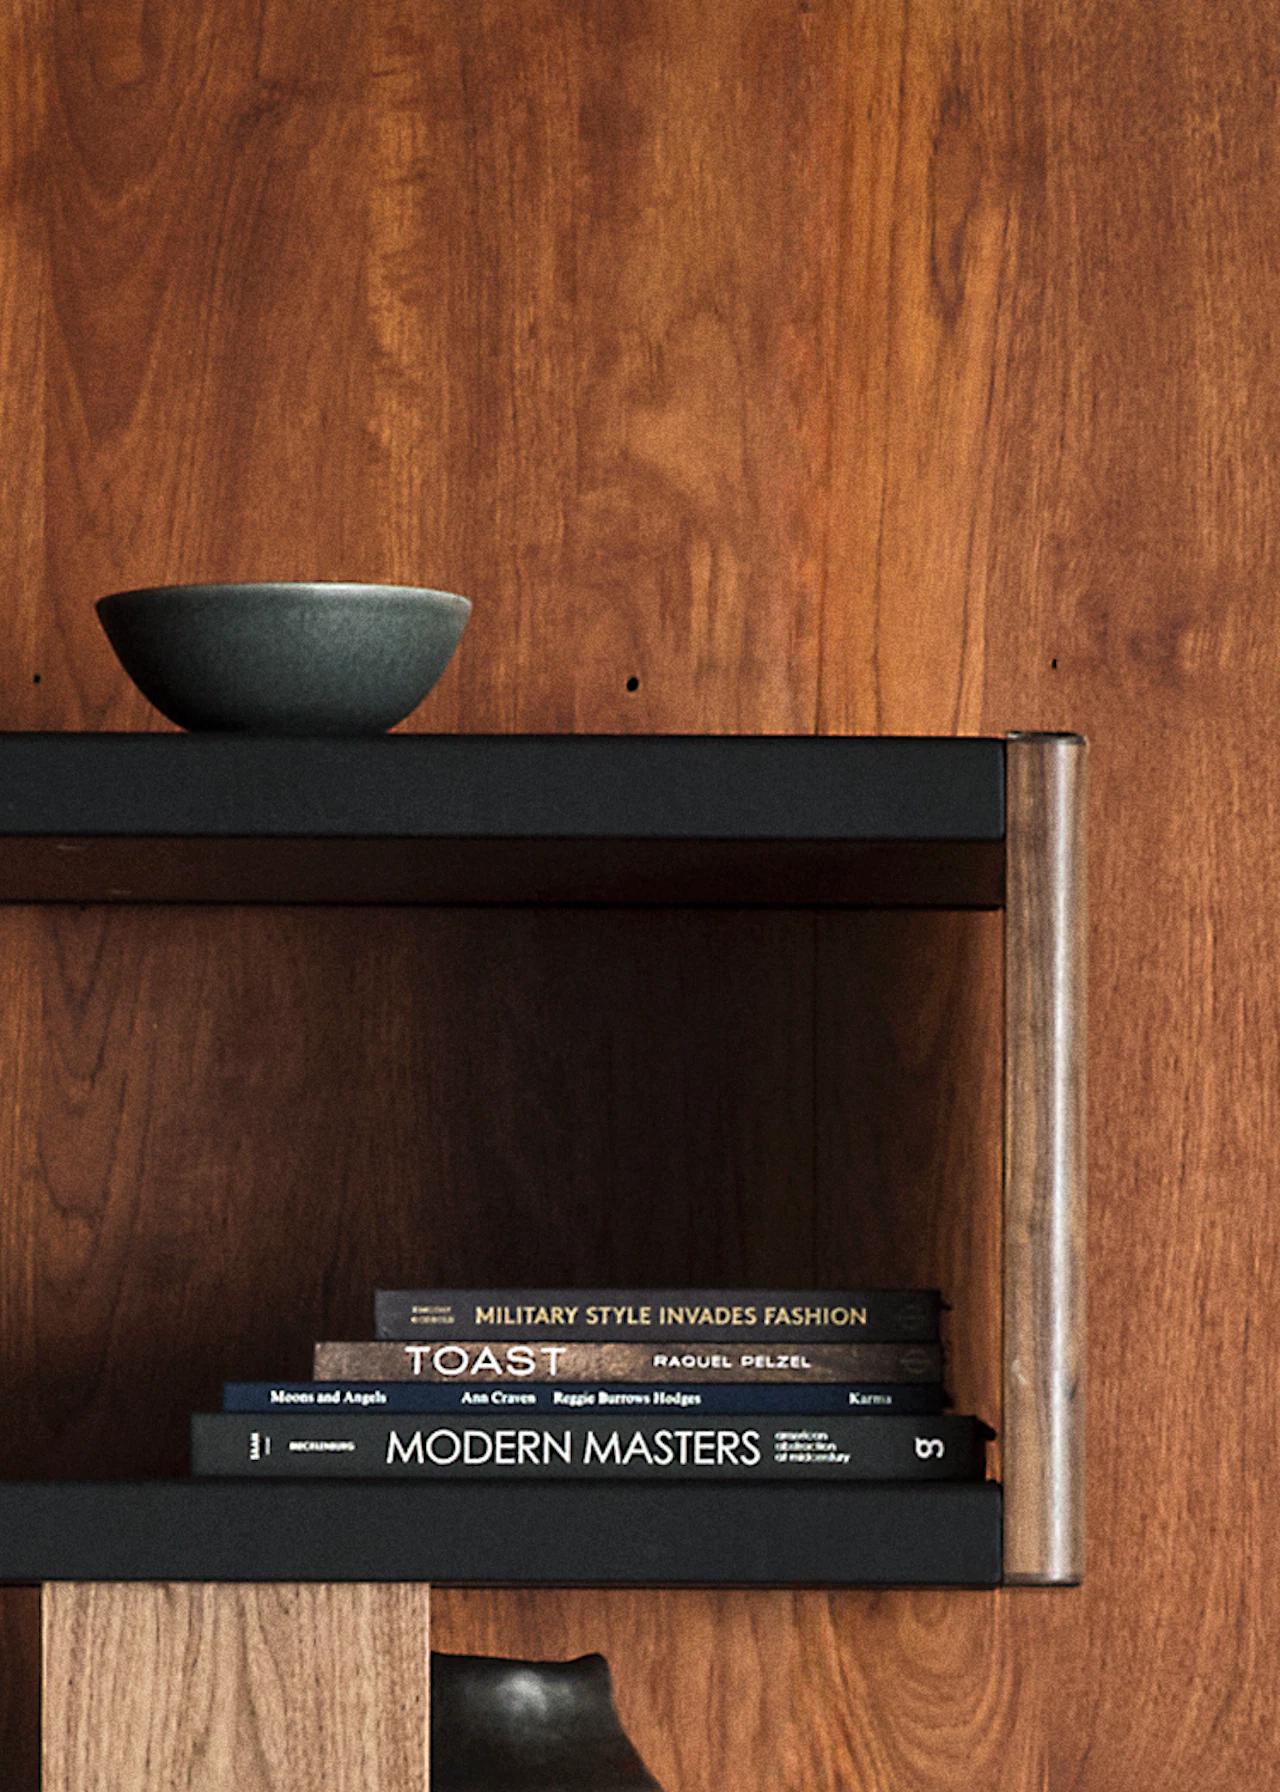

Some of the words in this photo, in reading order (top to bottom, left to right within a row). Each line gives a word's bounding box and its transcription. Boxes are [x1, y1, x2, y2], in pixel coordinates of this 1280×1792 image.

[475, 1306, 579, 1325] MILITARY
[586, 1306, 651, 1325] STYLE
[659, 1306, 757, 1326] INVADES
[763, 1306, 868, 1326] FASHION
[404, 1346, 567, 1377] TOAST
[652, 1354, 733, 1369] RAQUEL
[739, 1354, 812, 1369] PELZEL
[270, 1390, 314, 1404] Moons
[316, 1390, 341, 1404] and
[342, 1391, 388, 1407] Angels
[460, 1391, 489, 1404] Ann
[490, 1391, 538, 1405] Craven
[553, 1391, 596, 1407] Reggie
[598, 1391, 651, 1405] Burrows
[652, 1391, 702, 1407] Hodges
[848, 1391, 892, 1405] Karma
[386, 1429, 571, 1465] MODERN
[583, 1429, 761, 1466] MASTERS
